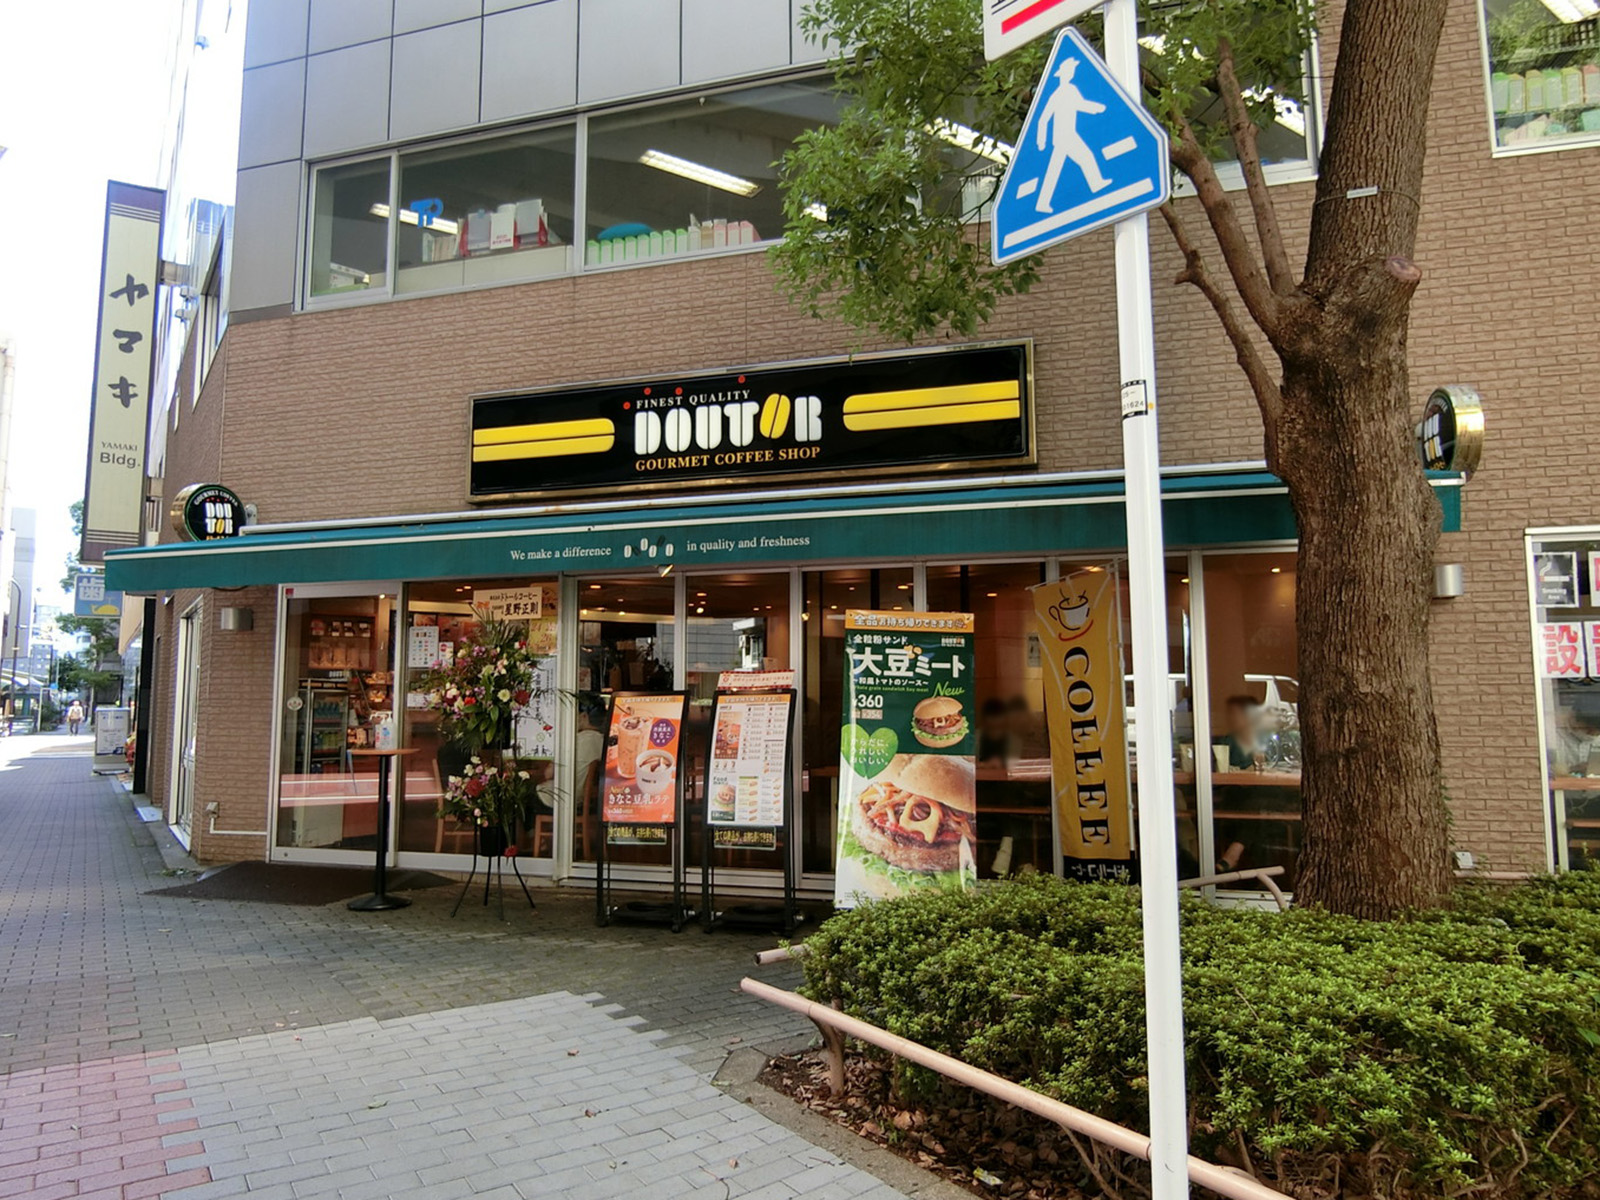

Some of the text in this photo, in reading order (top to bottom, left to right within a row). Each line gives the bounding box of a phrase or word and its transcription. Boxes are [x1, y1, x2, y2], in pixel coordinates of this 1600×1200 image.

[108, 273, 149, 408] ヤマキ
[636, 389, 751, 410] FINEST QUALITY
[634, 393, 823, 456] DOUTOR
[101, 441, 138, 451] YAMAKI
[635, 446, 821, 471] GOURMET COFFEE SHOP
[100, 452, 141, 469] Bldg.
[510, 550, 525, 560] We
[527, 548, 552, 559] make
[562, 546, 612, 558] difference
[687, 540, 697, 551] in
[699, 538, 735, 552] quality
[738, 537, 757, 549] and
[760, 535, 811, 547] freshness
[79, 577, 105, 602] 歯
[853, 634, 908, 645] 全粒粉サンド
[852, 646, 966, 678] 大豆ミート
[932, 681, 965, 699] New
